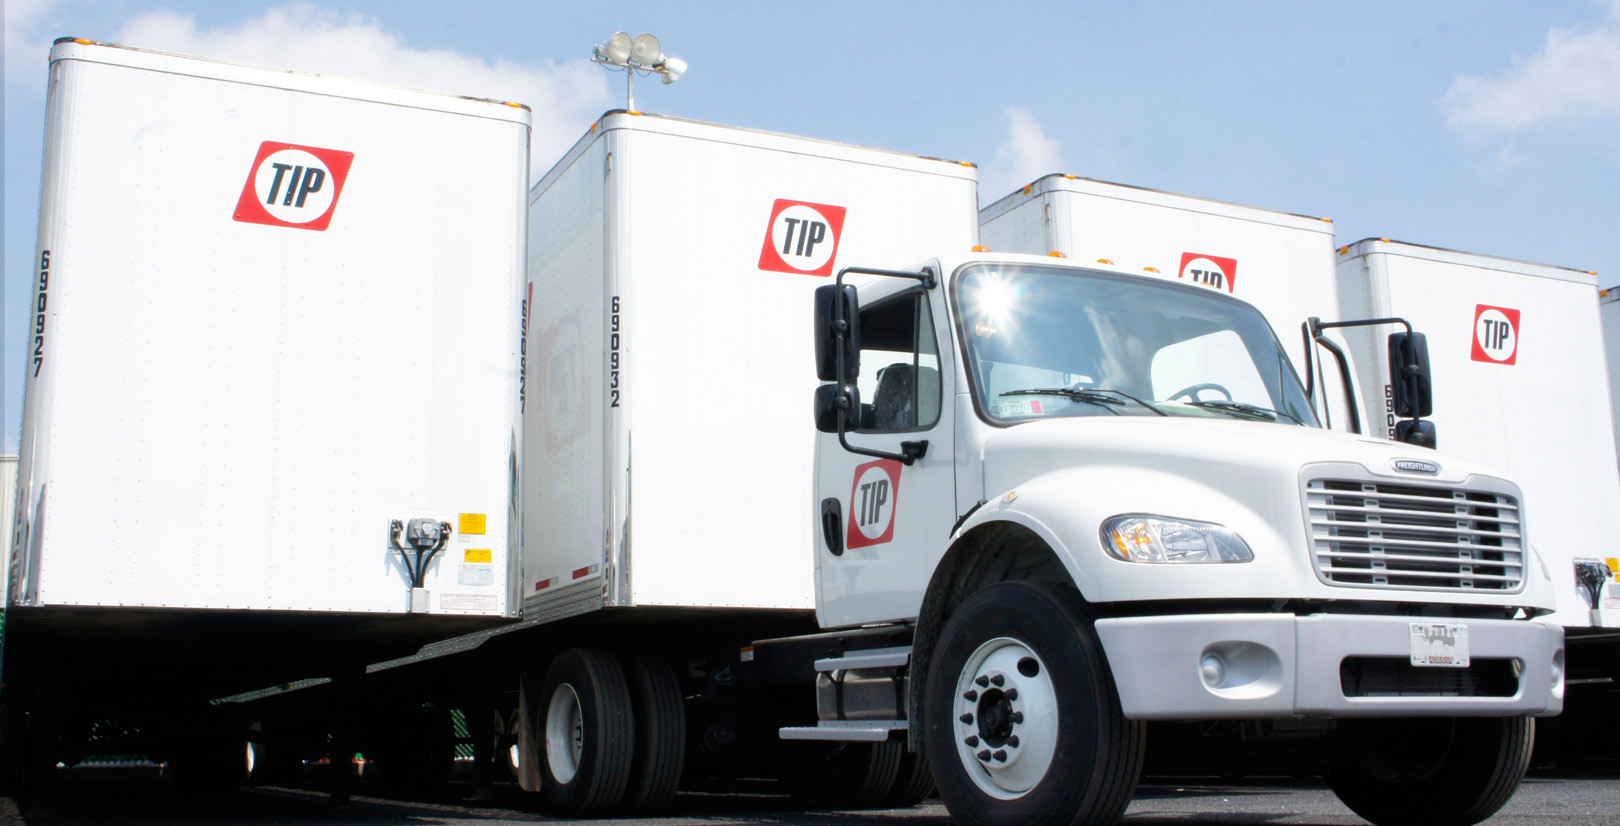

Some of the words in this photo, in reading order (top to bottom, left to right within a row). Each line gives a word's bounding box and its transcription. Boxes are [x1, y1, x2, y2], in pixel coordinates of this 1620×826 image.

[266, 162, 326, 208] TIP
[783, 217, 826, 257] TIP
[34, 249, 50, 378] 690927
[1483, 319, 1510, 350] TIP
[611, 296, 620, 408] 690932
[860, 479, 889, 526] TIP
